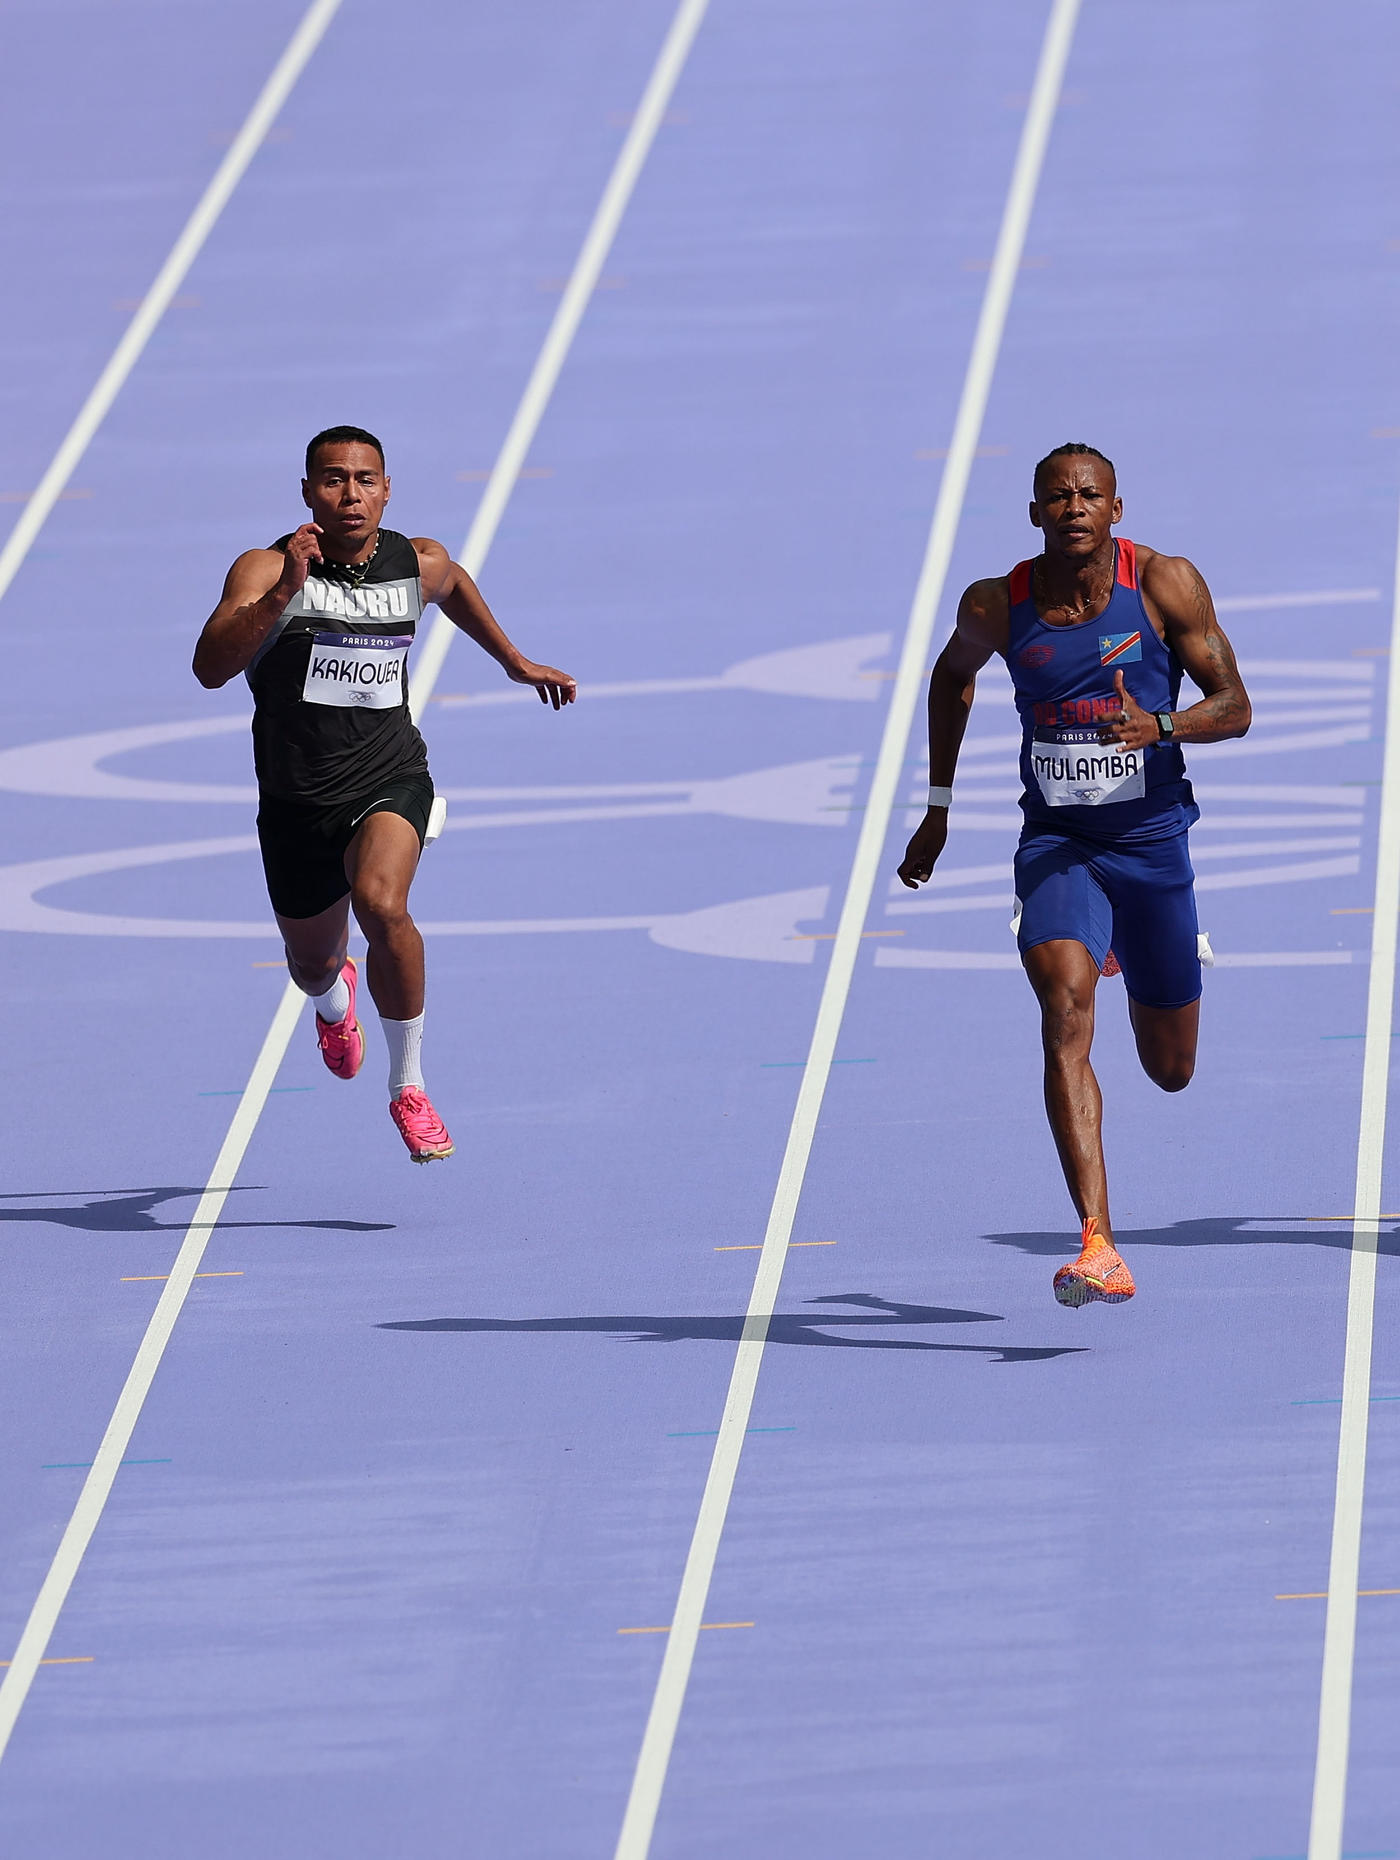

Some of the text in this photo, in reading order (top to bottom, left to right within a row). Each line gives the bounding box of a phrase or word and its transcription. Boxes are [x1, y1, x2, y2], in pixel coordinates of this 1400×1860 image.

[303, 581, 408, 617] NAURU
[342, 637, 368, 645] PARIS
[311, 657, 399, 685] KAKIOUEA
[1061, 697, 1130, 724] CONG
[1057, 733, 1083, 741] PARIS
[1035, 753, 1138, 780] MULAMBA
